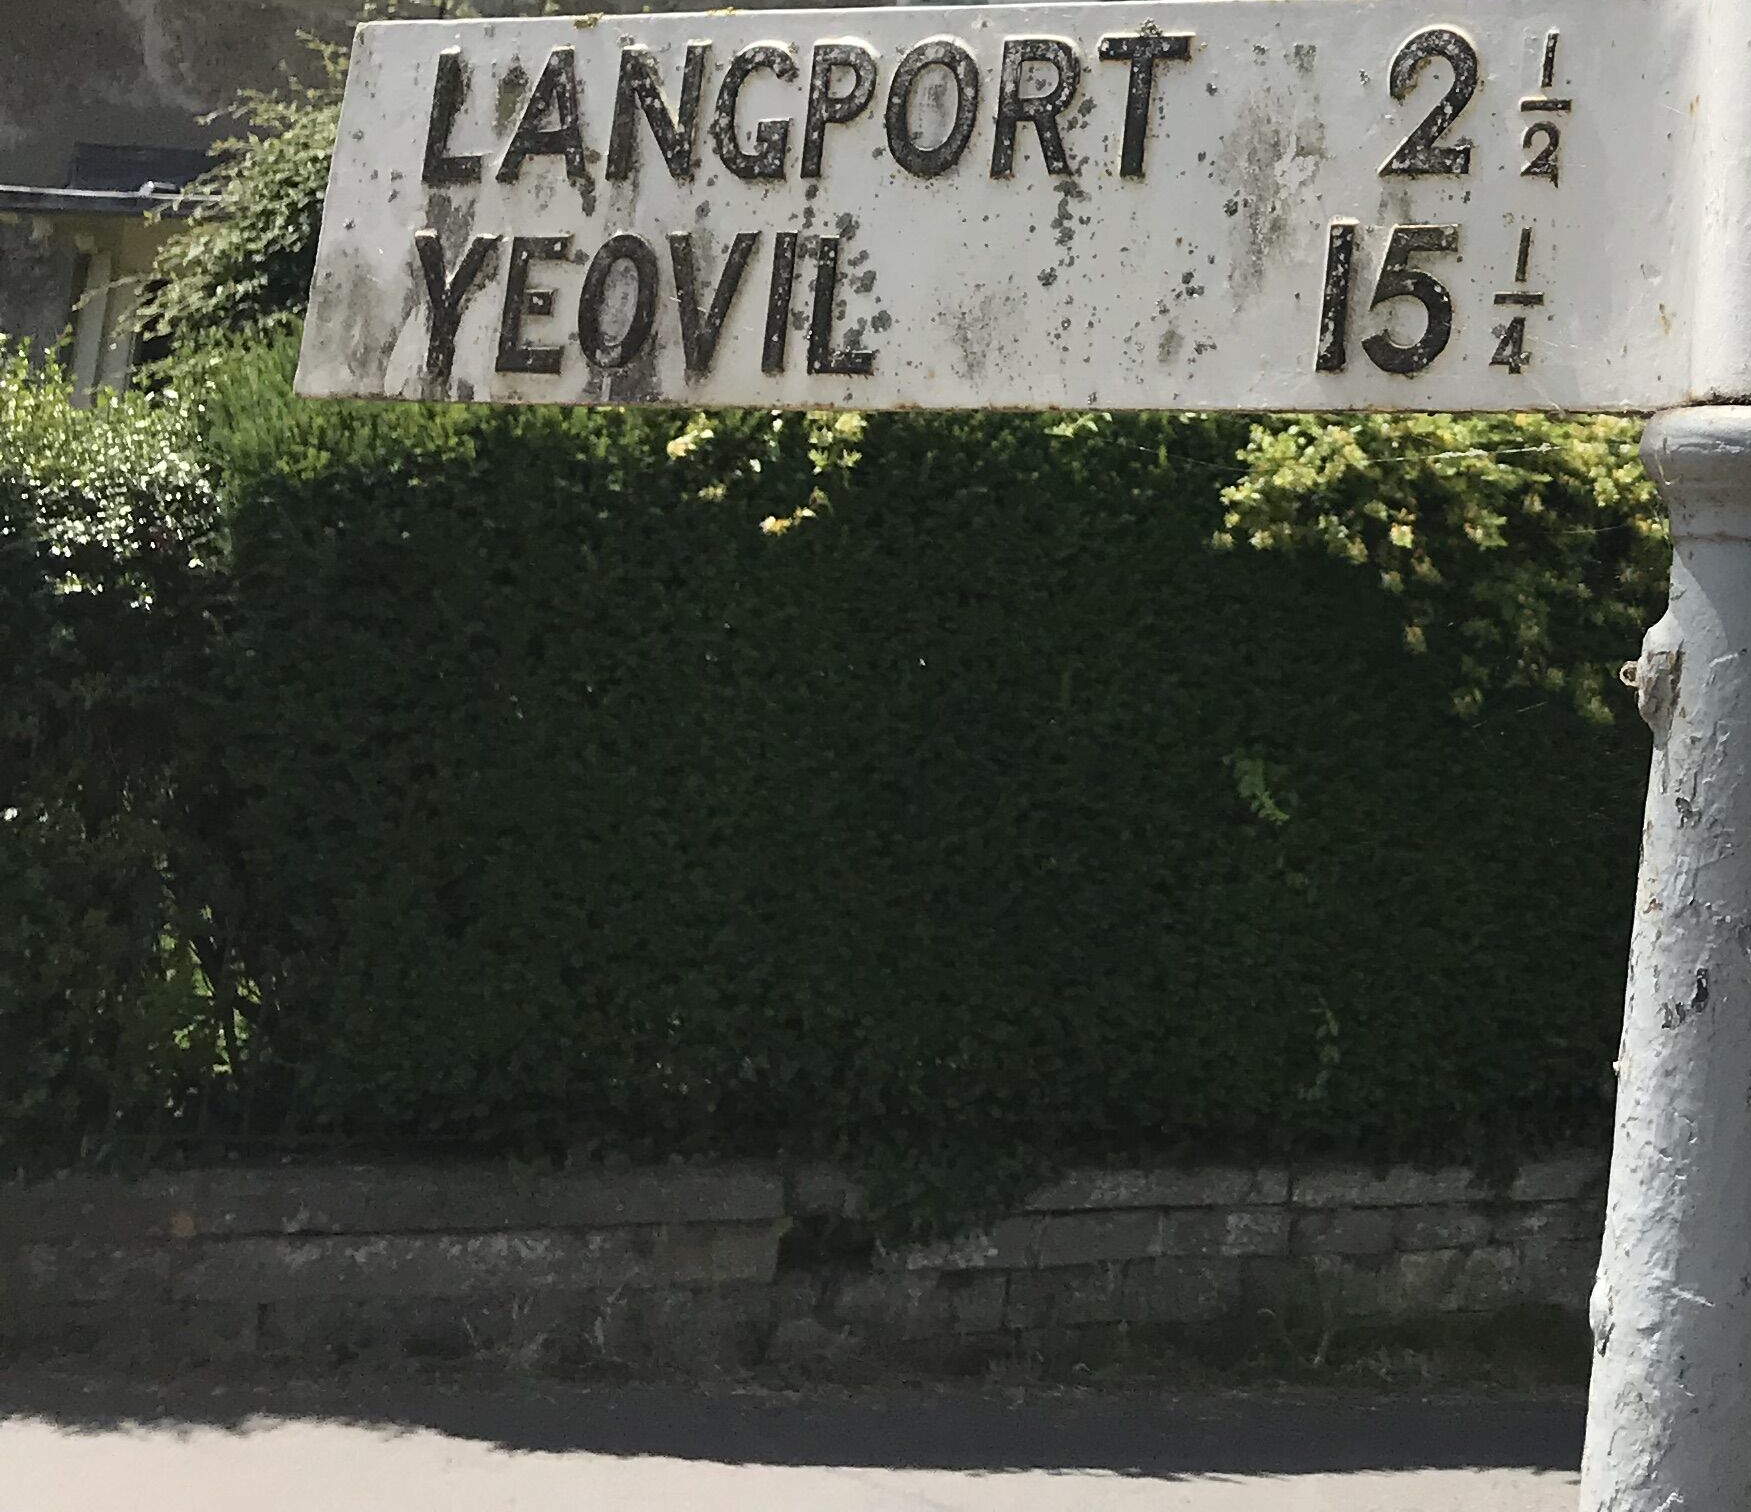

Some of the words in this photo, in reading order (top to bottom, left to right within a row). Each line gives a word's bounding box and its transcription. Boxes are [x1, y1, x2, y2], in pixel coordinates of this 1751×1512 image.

[421, 30, 1195, 186] LANGPORT
[1377, 26, 1478, 177] 2
[415, 228, 877, 379] YEOVIL
[1315, 219, 1461, 374] 15
